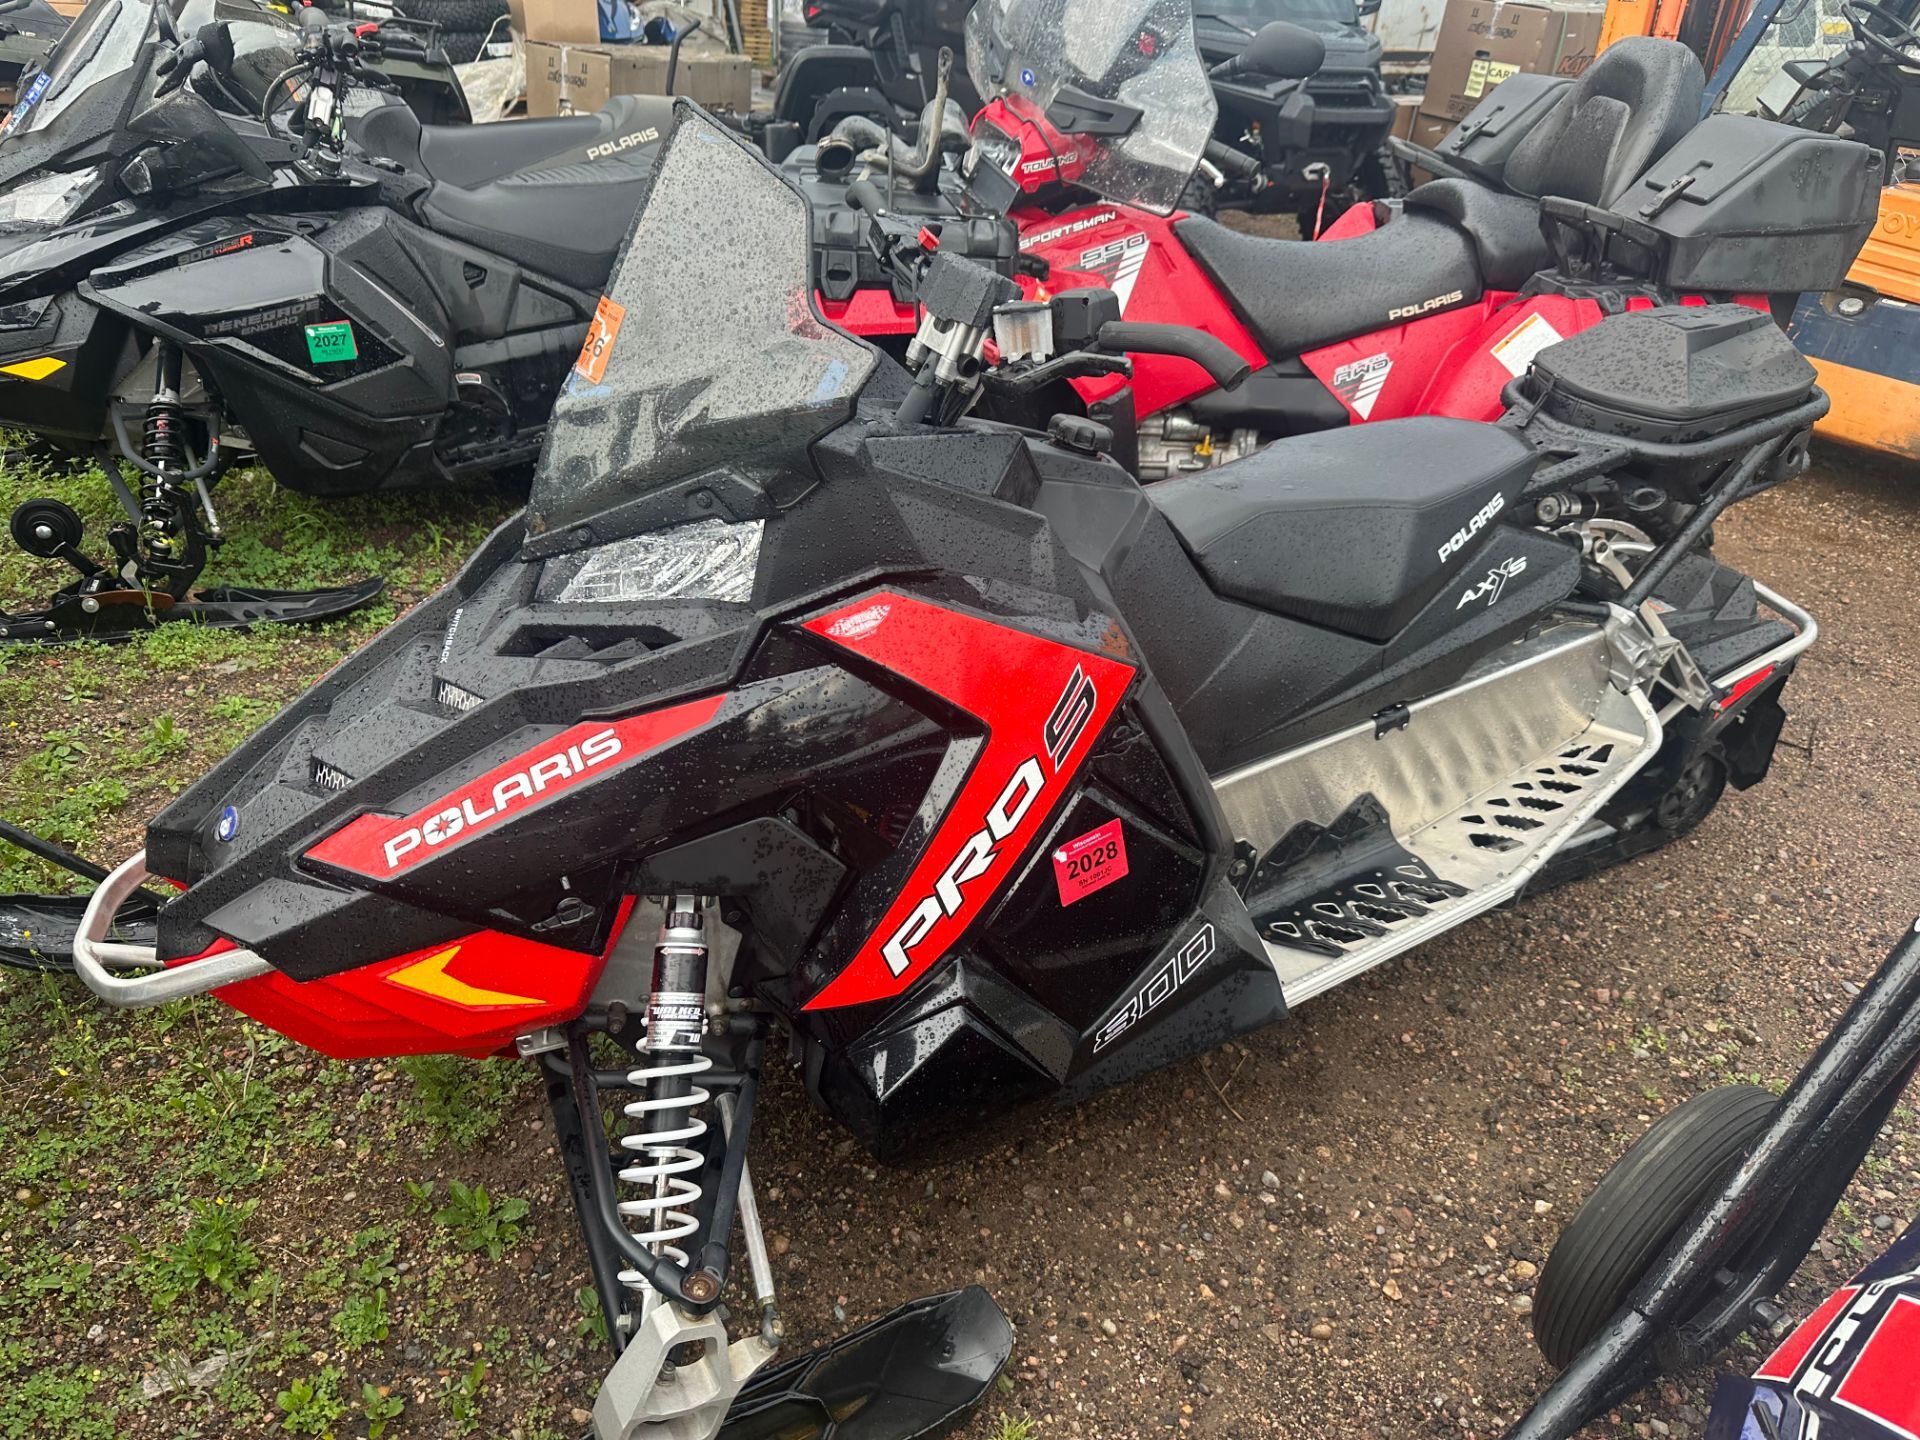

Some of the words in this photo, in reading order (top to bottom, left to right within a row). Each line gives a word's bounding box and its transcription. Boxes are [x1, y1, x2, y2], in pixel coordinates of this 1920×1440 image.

[586, 126, 660, 161] POLARIS
[1019, 211, 1116, 250] SPORTSMAN
[1080, 232, 1147, 266] 550
[204, 300, 320, 334] RENEGADE
[1389, 290, 1463, 320] POLARIS
[241, 315, 299, 336] ENDURO
[313, 334, 347, 349] 2027
[1438, 492, 1505, 563] POLARIS
[1456, 556, 1528, 610] AXYS
[440, 608, 463, 664] SWITCHBACK
[381, 728, 624, 869] POLARIS
[880, 755, 1046, 978] PRO
[1043, 662, 1097, 773] S
[1066, 841, 1119, 881] 2028
[1093, 922, 1216, 1053] 800
